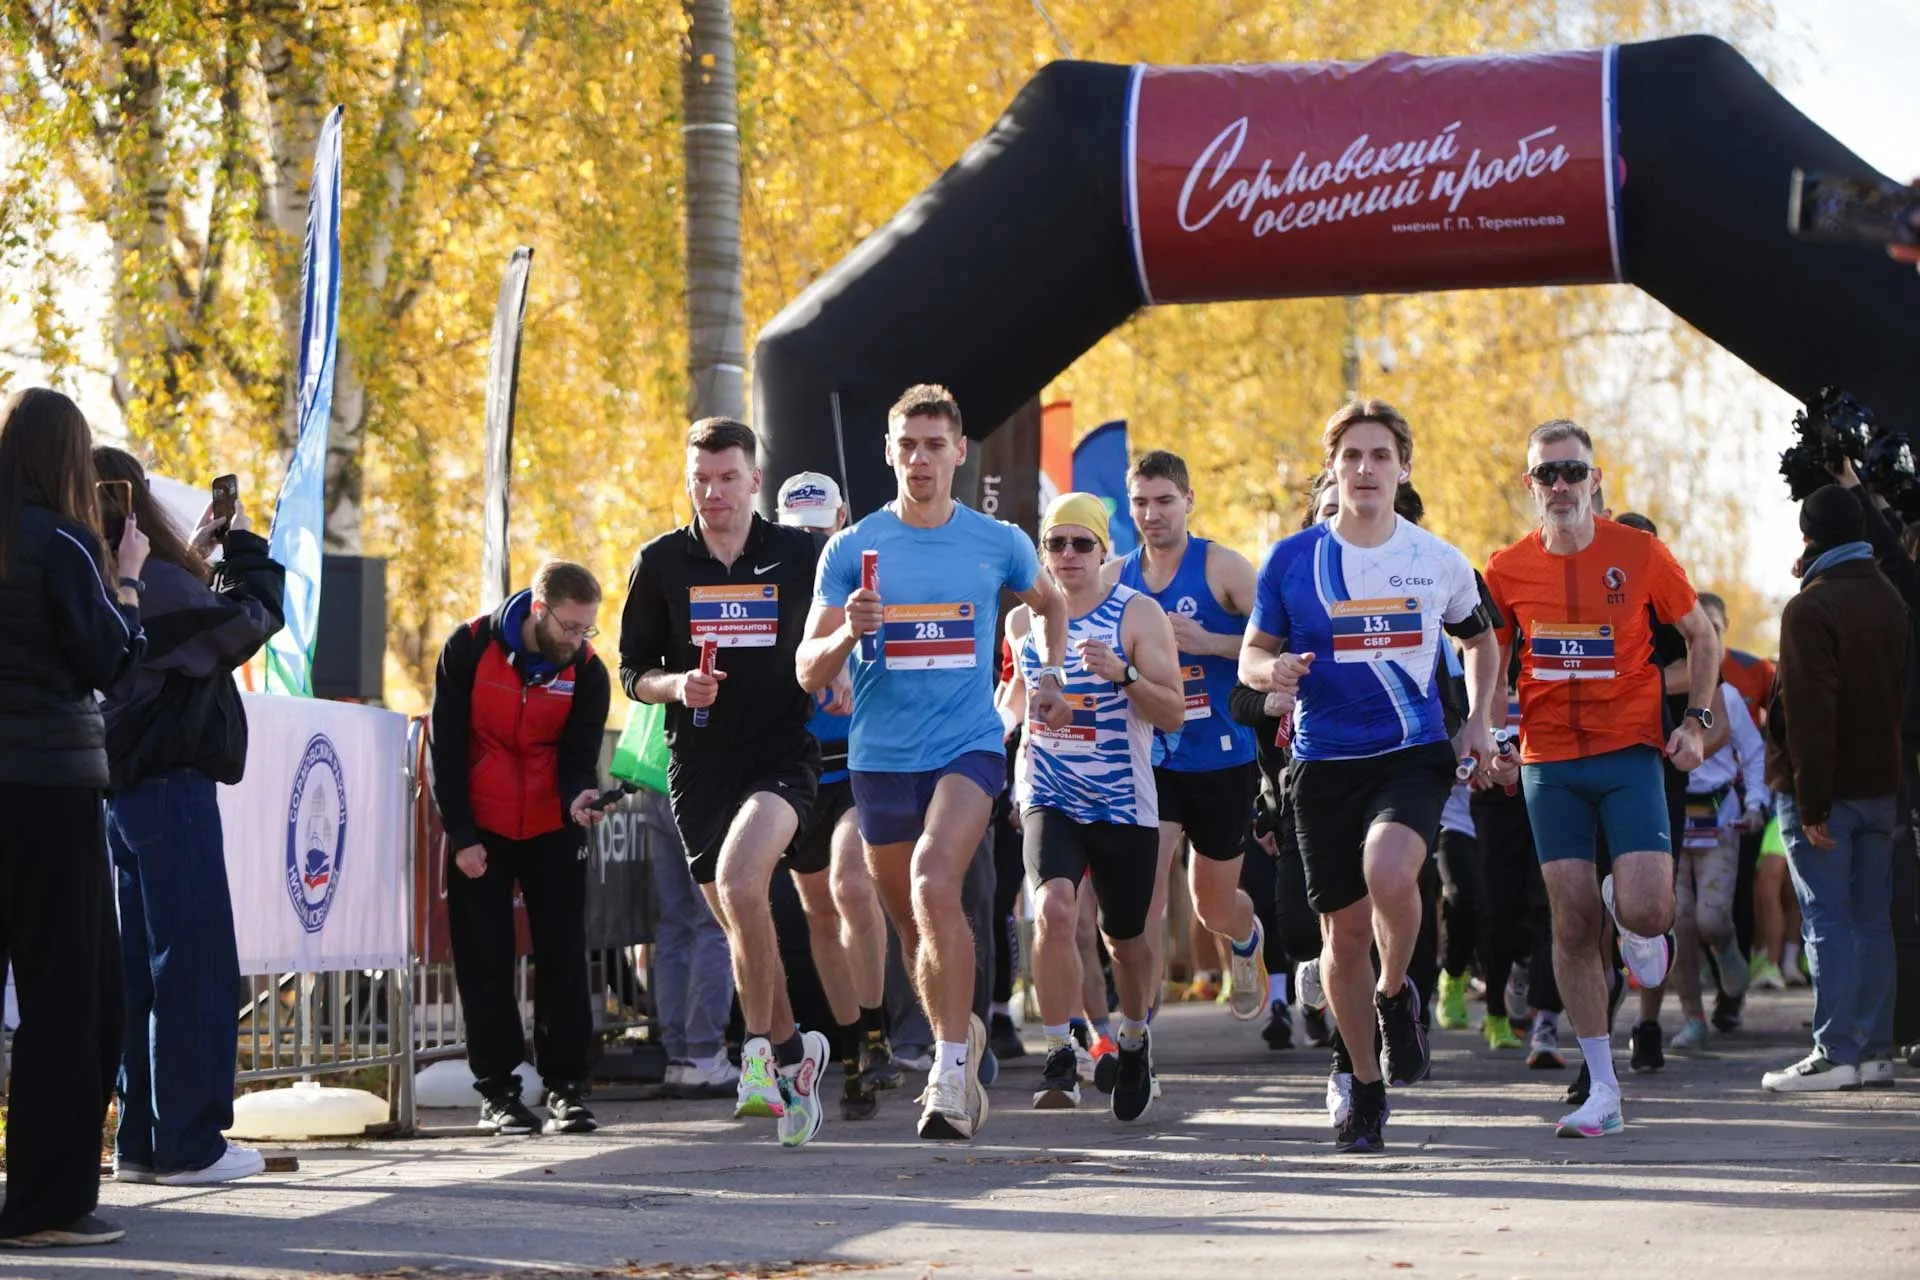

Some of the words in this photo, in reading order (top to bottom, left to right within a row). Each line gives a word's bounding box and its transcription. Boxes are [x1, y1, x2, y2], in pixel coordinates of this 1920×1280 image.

[1177, 116, 1462, 232] Сормовский
[1253, 166, 1424, 237] осенний
[1429, 125, 1569, 213] пробег
[1392, 222, 1440, 233] имени
[1476, 214, 1566, 232] Терентьева
[1405, 577, 1434, 586] СБЕР
[1363, 637, 1392, 647] СБЕР
[1563, 660, 1581, 668] СТТ
